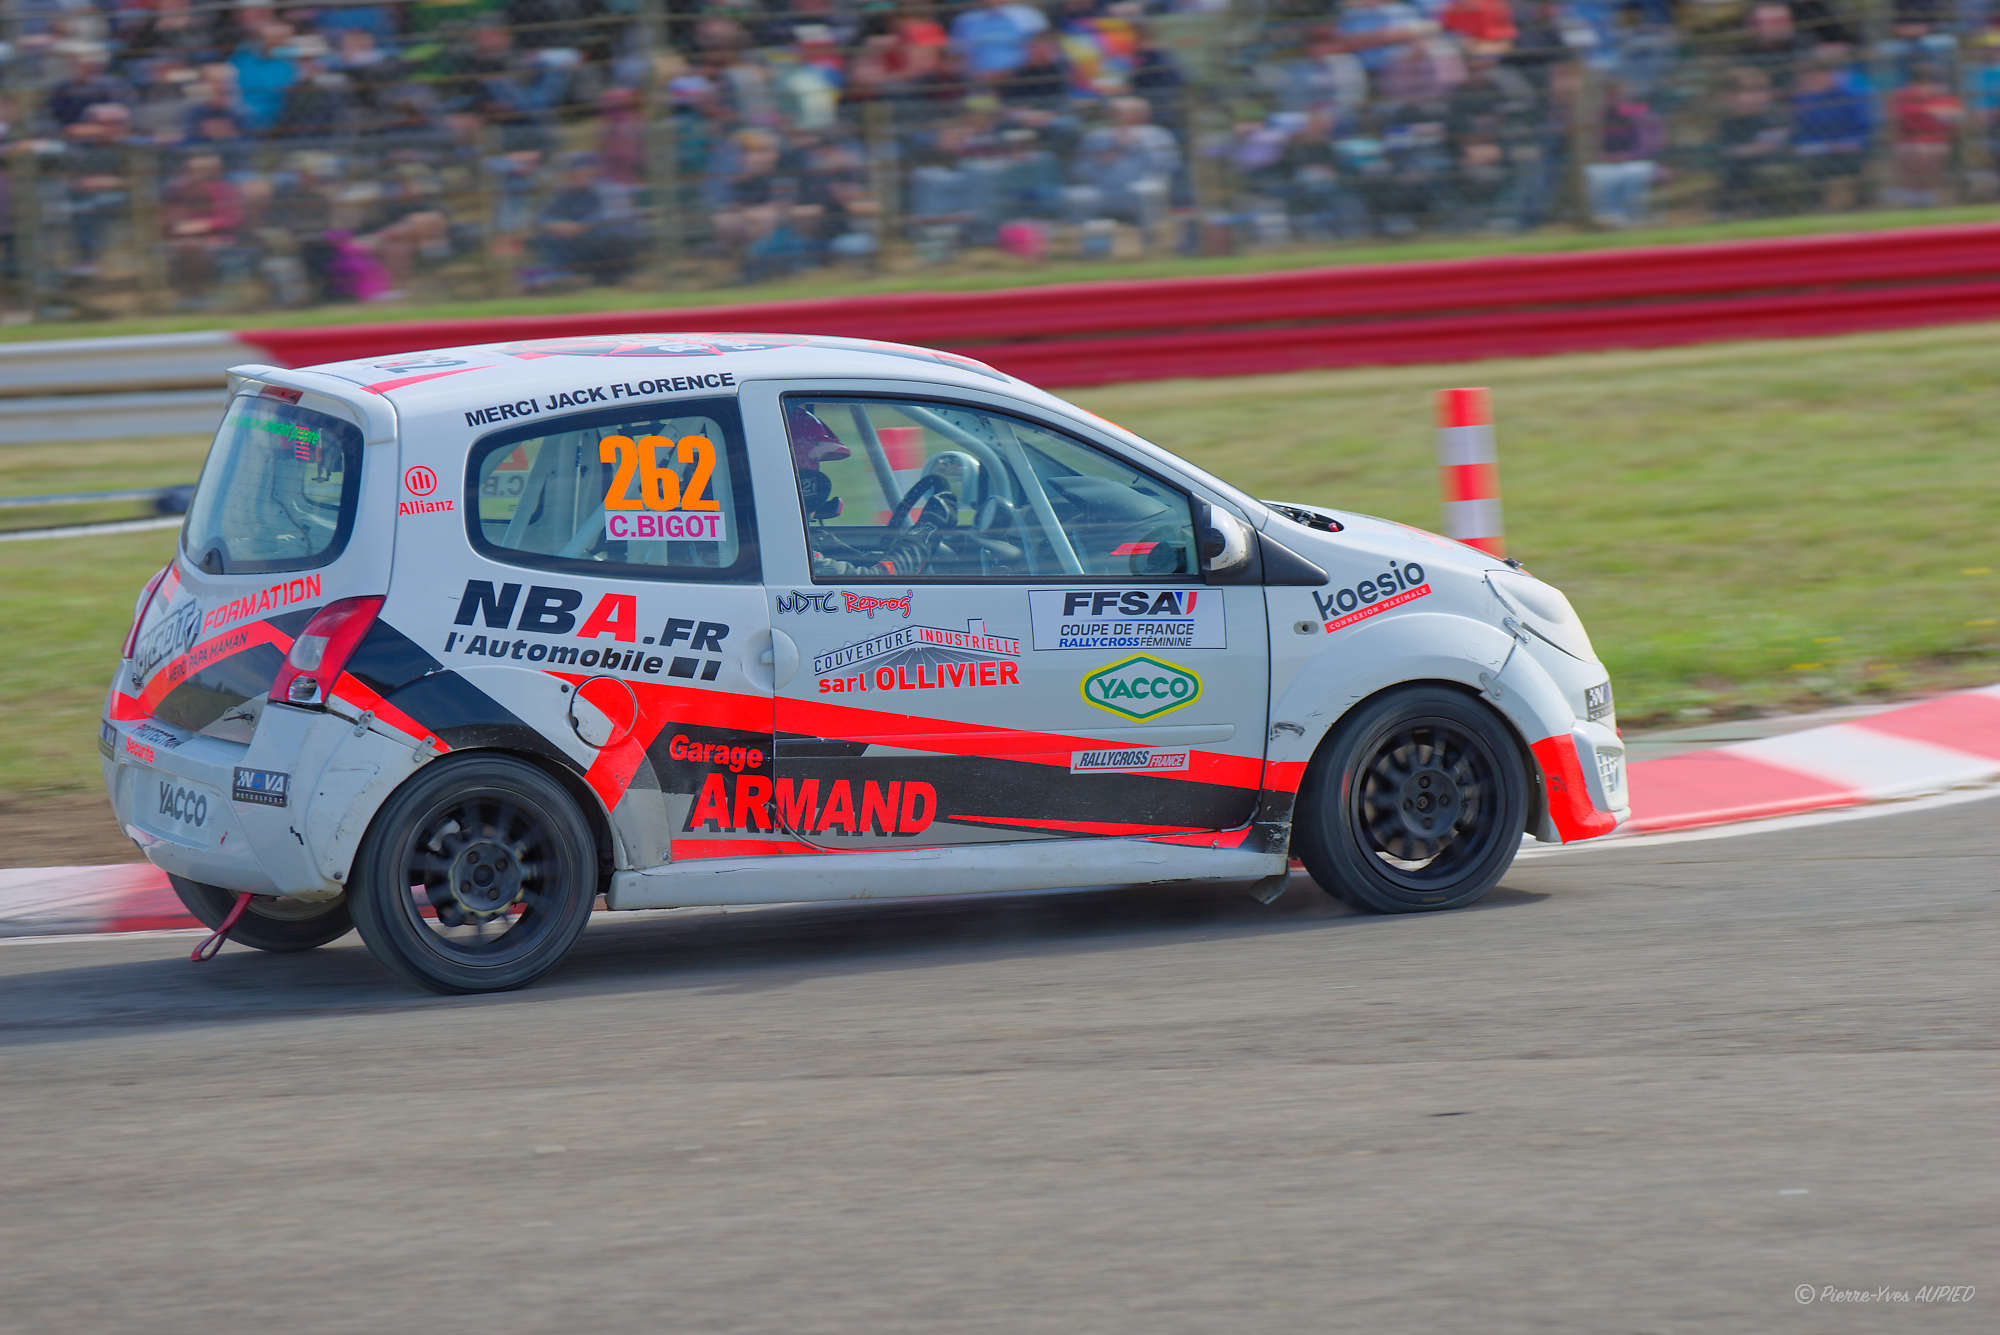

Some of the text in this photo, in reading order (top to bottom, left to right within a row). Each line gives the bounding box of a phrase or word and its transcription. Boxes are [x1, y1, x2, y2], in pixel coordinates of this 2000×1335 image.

[464, 372, 736, 427] MERCI JACK FLORENCE
[599, 435, 720, 512] 262
[398, 499, 455, 516] Allianz
[609, 515, 720, 538] C.BIGOT
[202, 573, 321, 634] FORMATION
[777, 590, 838, 614] NDTC
[1063, 591, 1182, 616] FFSA
[1312, 560, 1425, 621] koesio
[1329, 587, 1427, 631] CONNEXION MAXIMALE
[209, 631, 249, 659] MAMAN
[1059, 637, 1140, 648] RALLYCROSS
[1060, 623, 1194, 636] COUPE DE FRANCE
[444, 632, 664, 674] l'Automobile
[814, 628, 1021, 673] COUVERTURE INDUSTRIELLE
[818, 661, 1020, 694] sarl OLLIVIER
[1097, 677, 1188, 699] YACCO
[669, 734, 763, 772] Garage
[1080, 750, 1185, 768] RALLYCROSS FRANCE
[160, 781, 207, 827] YACCO
[686, 772, 937, 834] ARMAND
